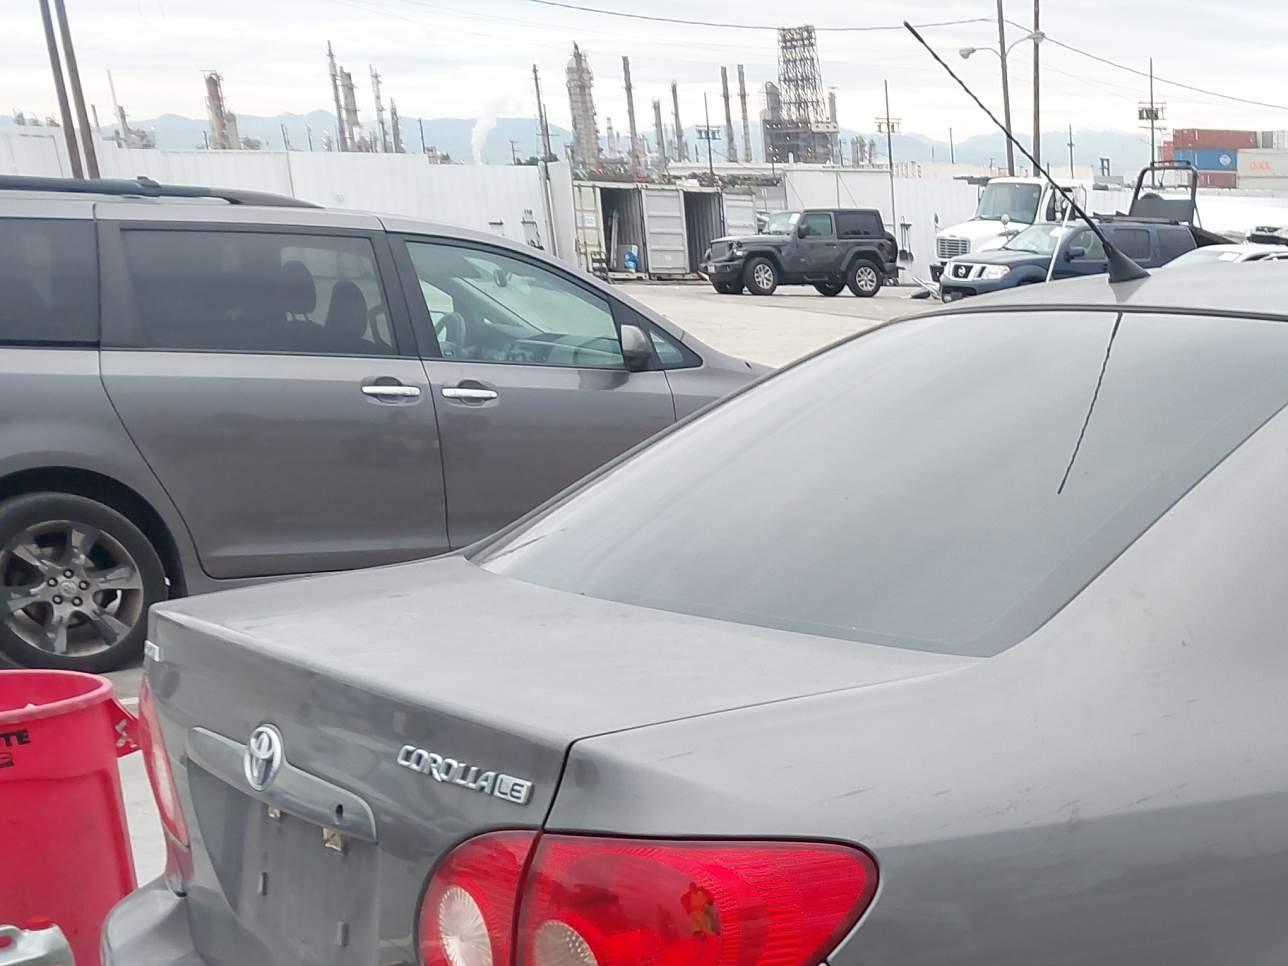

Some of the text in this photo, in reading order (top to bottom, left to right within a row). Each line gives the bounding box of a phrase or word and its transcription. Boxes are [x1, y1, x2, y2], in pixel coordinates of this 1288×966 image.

[0, 729, 31, 747] TE
[397, 745, 530, 803] COROLLA LE
